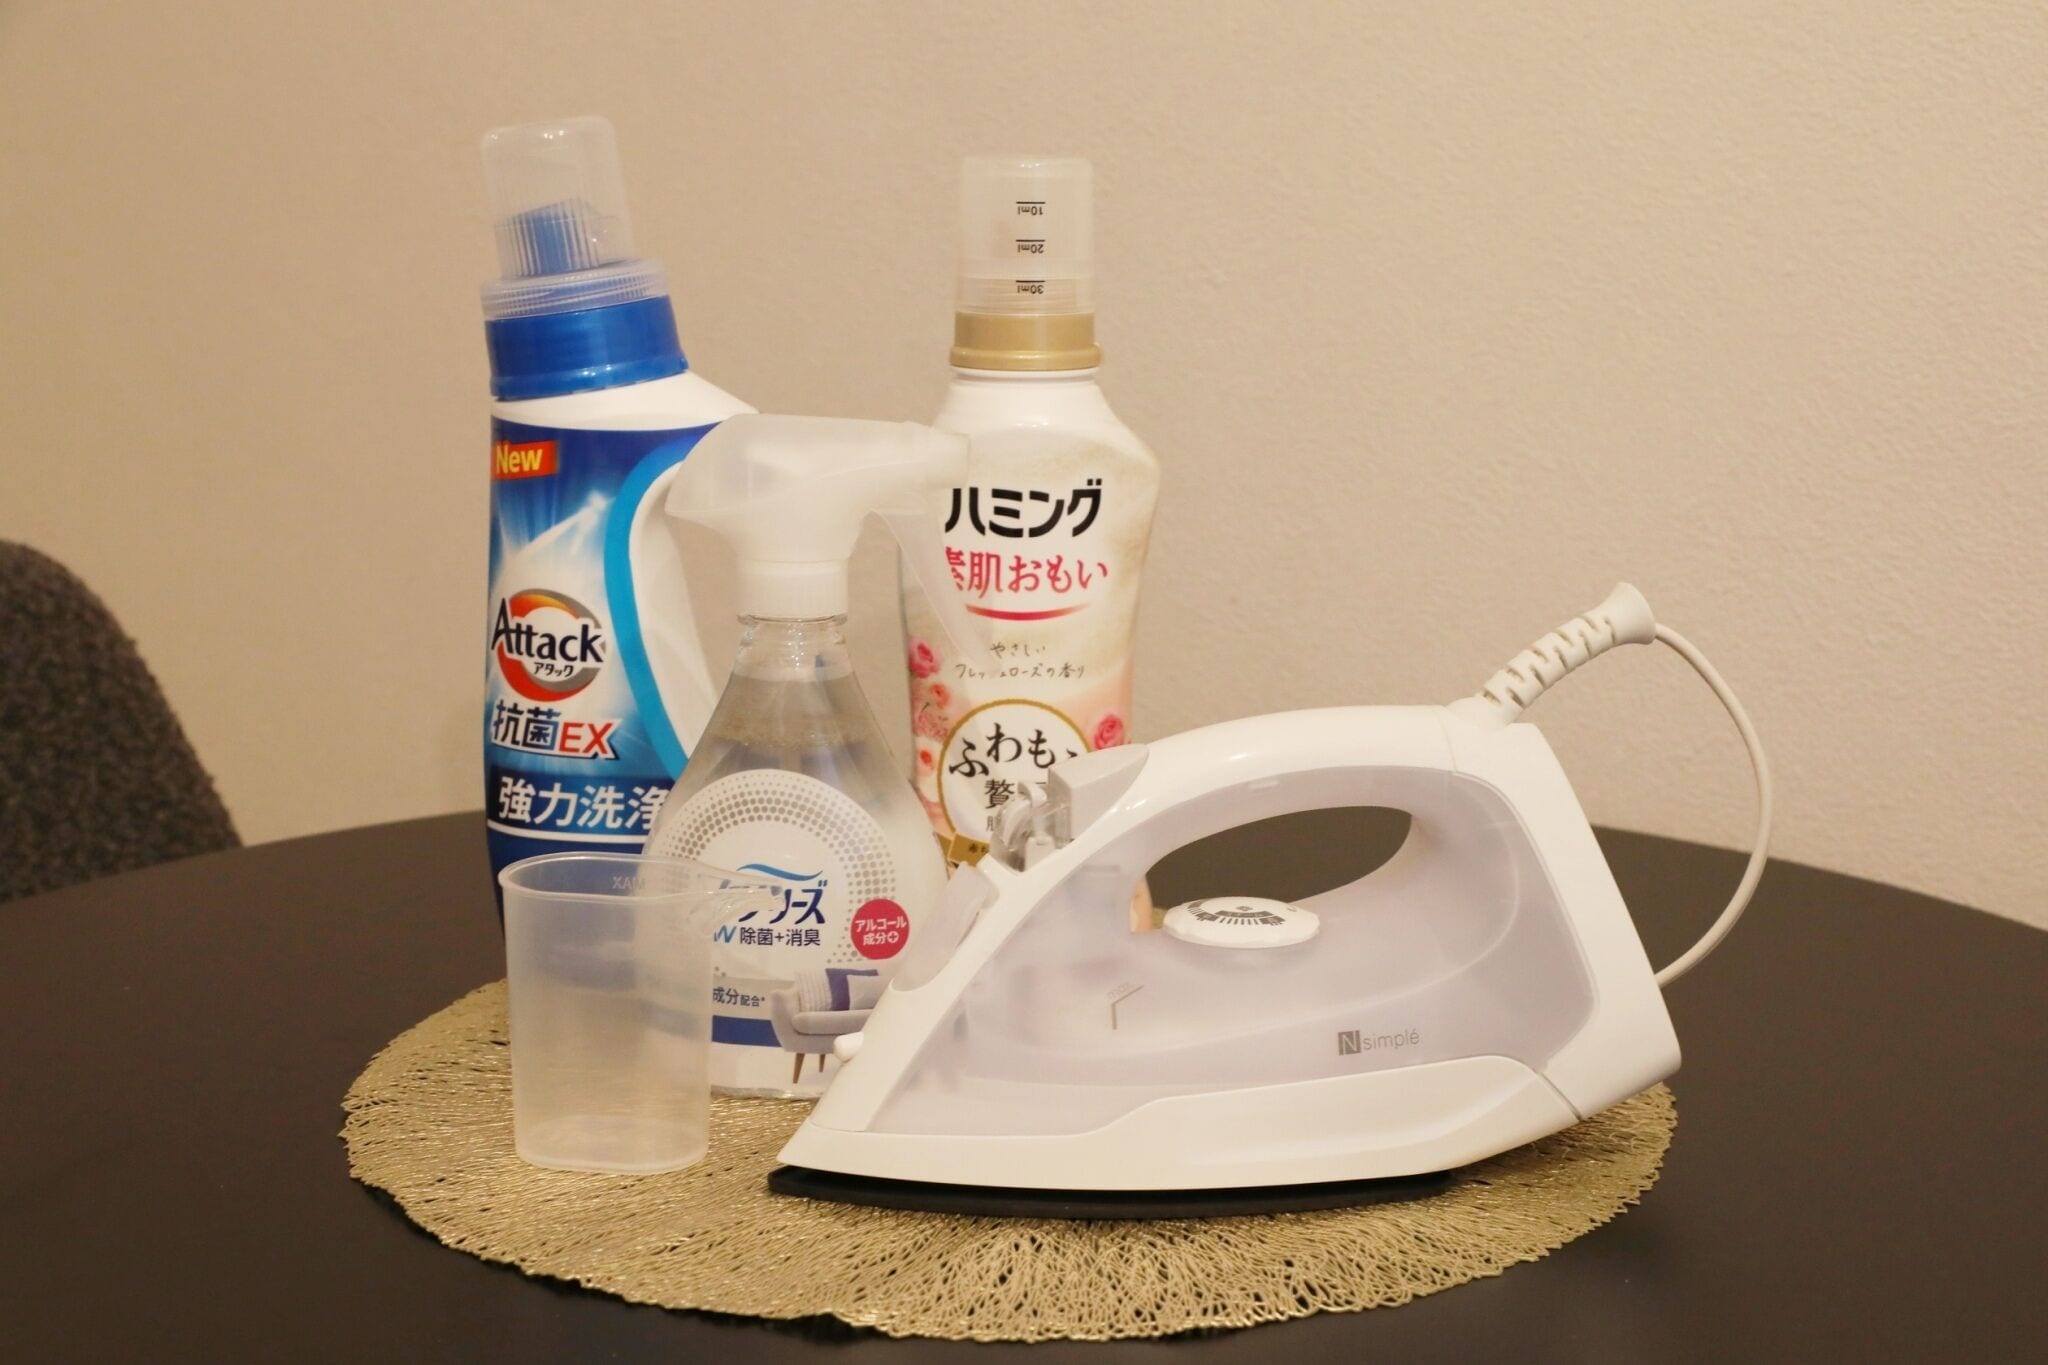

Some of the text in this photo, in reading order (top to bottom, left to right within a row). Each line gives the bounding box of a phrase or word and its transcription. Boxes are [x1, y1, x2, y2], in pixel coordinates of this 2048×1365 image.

[1017, 206, 1044, 216] 10ml
[1017, 244, 1045, 254] 20ml
[1017, 284, 1045, 294] 30ml
[495, 443, 544, 474] New
[945, 478, 1103, 538] ハミング
[491, 597, 604, 663] Attack
[990, 641, 1047, 660] やさしい
[533, 661, 575, 678] アタック
[955, 661, 1086, 679] フレッュローズの香り
[948, 722, 1078, 778] ふわも
[854, 915, 908, 933] アルコール
